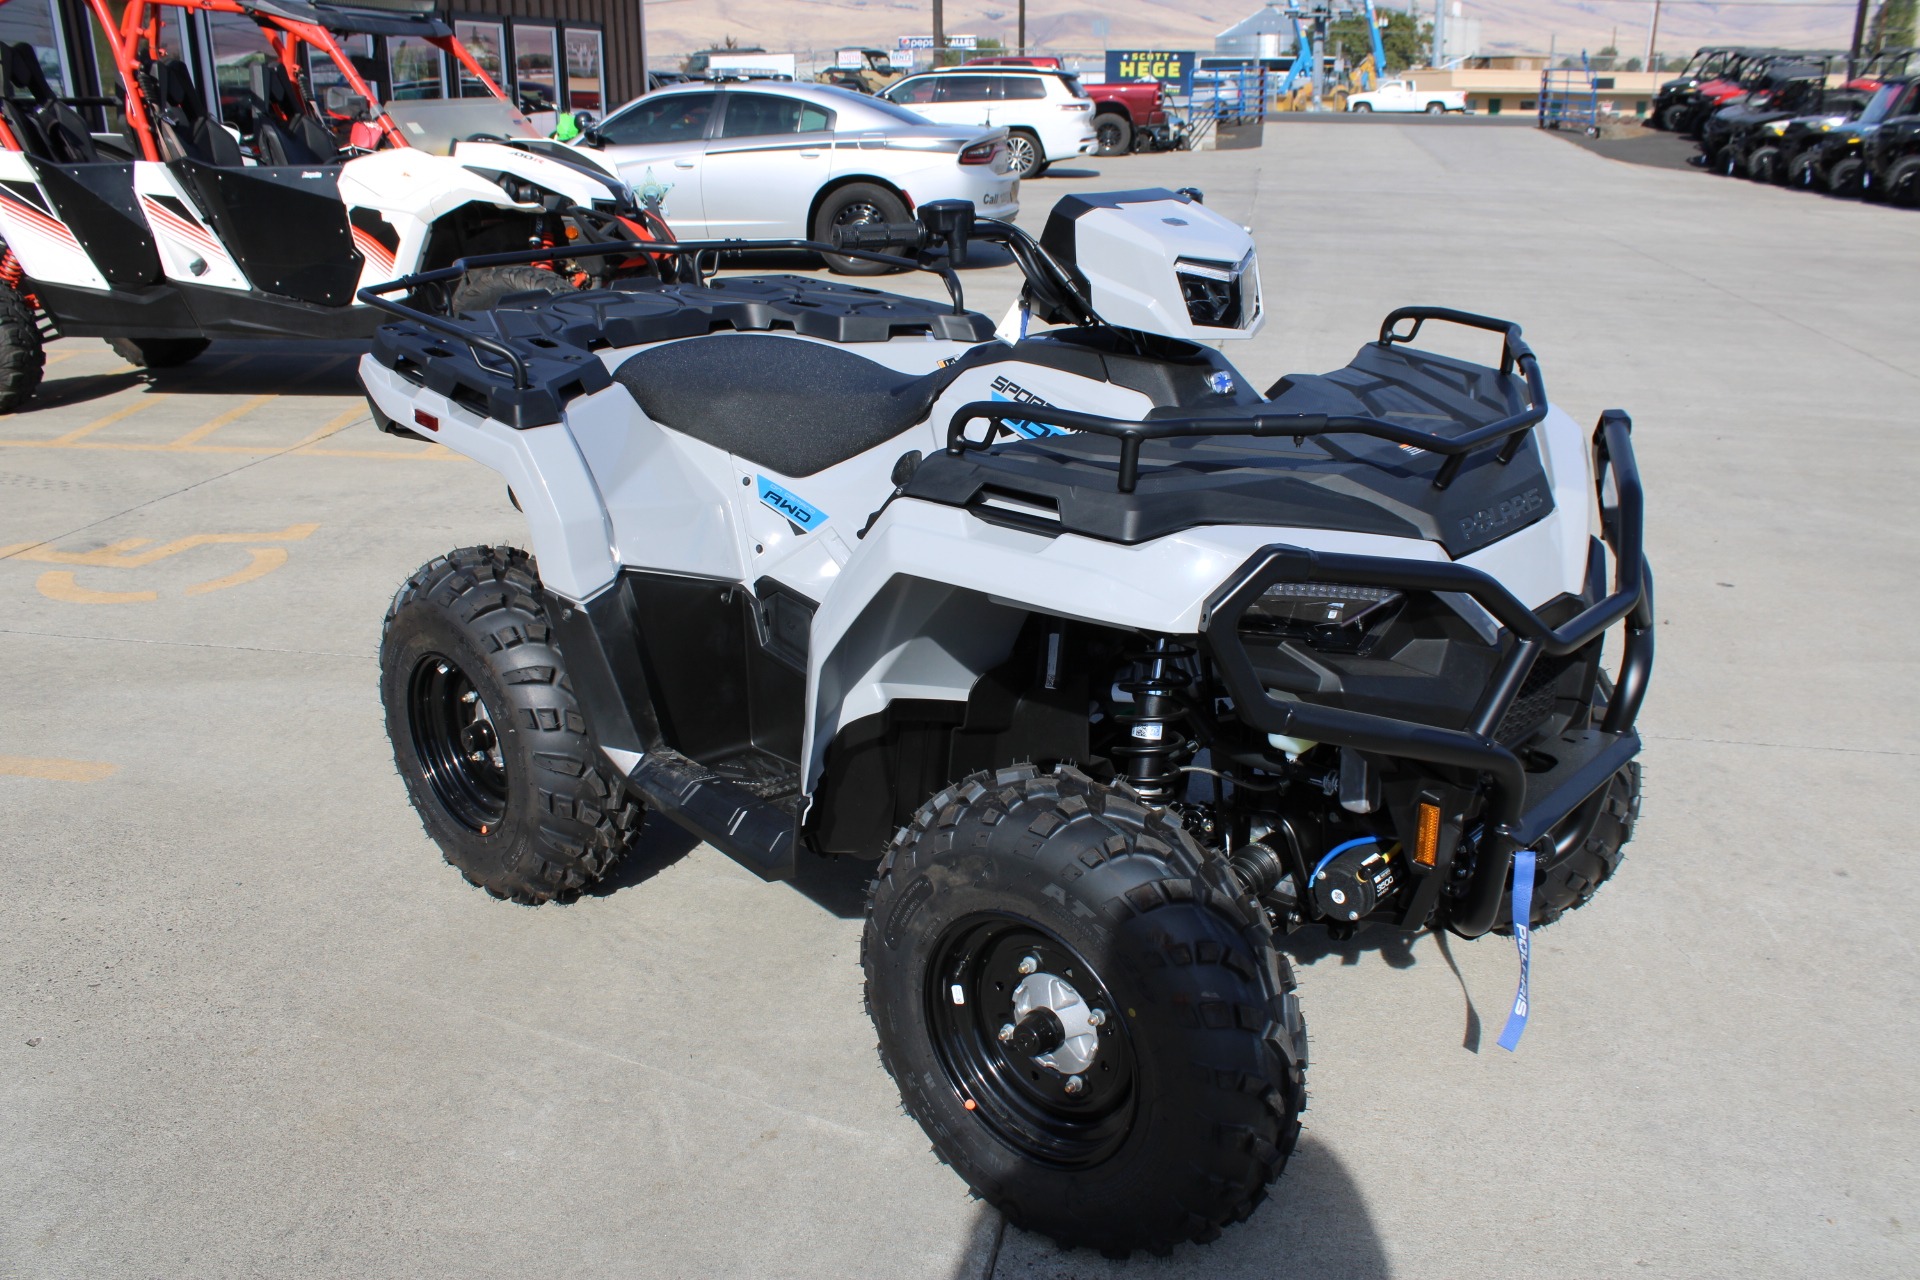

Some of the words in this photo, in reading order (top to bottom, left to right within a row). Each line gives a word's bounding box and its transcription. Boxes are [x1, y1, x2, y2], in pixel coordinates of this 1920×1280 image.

[910, 39, 934, 49] peps
[1132, 52, 1170, 61] SCOTT
[1120, 61, 1181, 78] HEGE
[983, 193, 998, 205] Call
[763, 490, 812, 523] AWD
[1458, 488, 1543, 541] POLARIS
